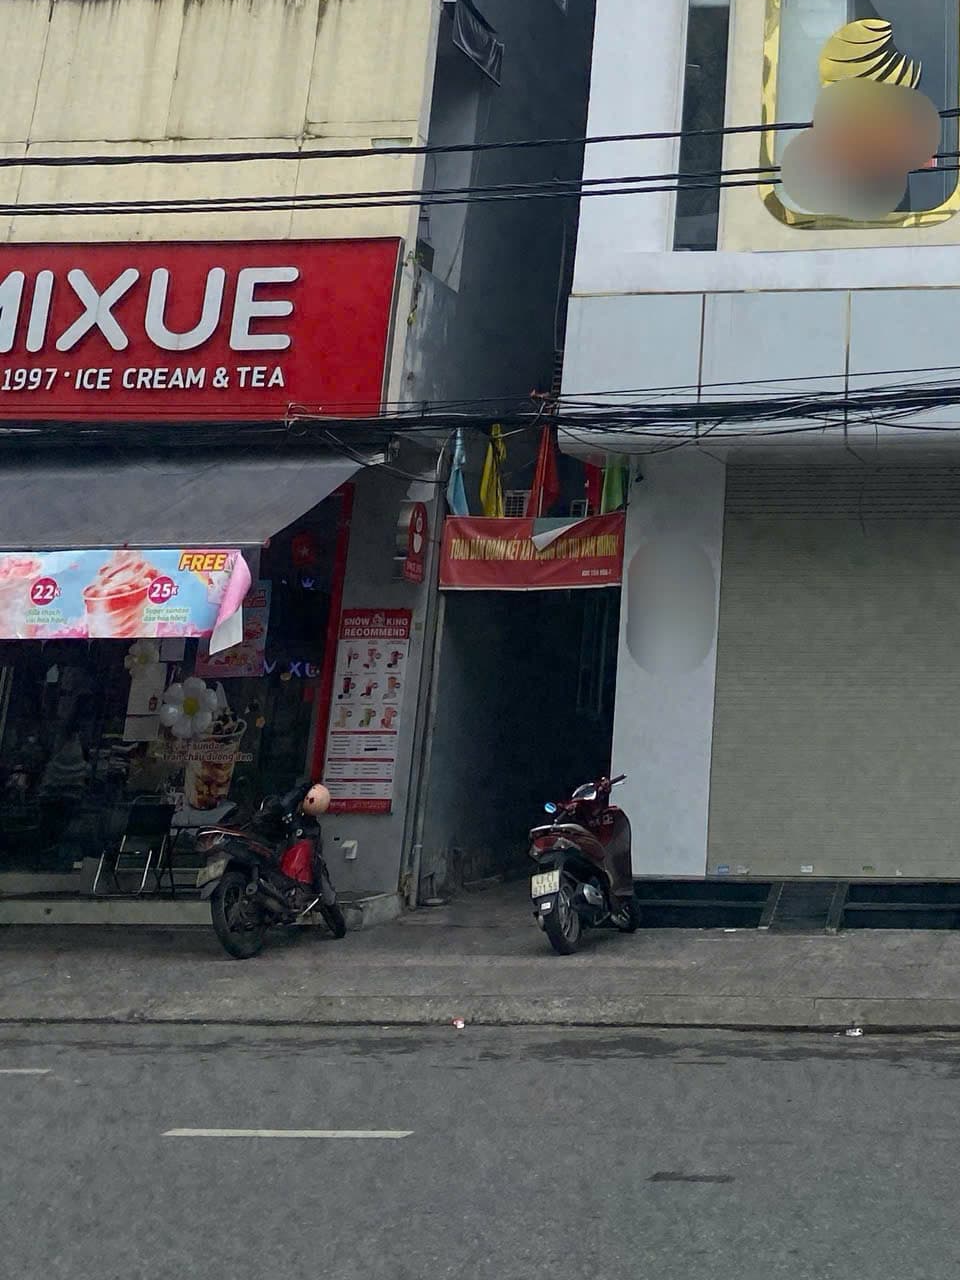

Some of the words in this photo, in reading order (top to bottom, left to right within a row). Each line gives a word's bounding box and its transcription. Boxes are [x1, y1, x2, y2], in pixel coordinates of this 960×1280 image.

[2, 367, 56, 391] 1997
[75, 368, 111, 390] ICE
[122, 367, 206, 390] CREAM
[212, 368, 230, 390] &
[236, 366, 286, 389] TEA
[179, 553, 228, 571] FREE
[344, 617, 370, 626] SNOW
[386, 617, 408, 626] KING
[344, 628, 405, 637] RECOMMEND
